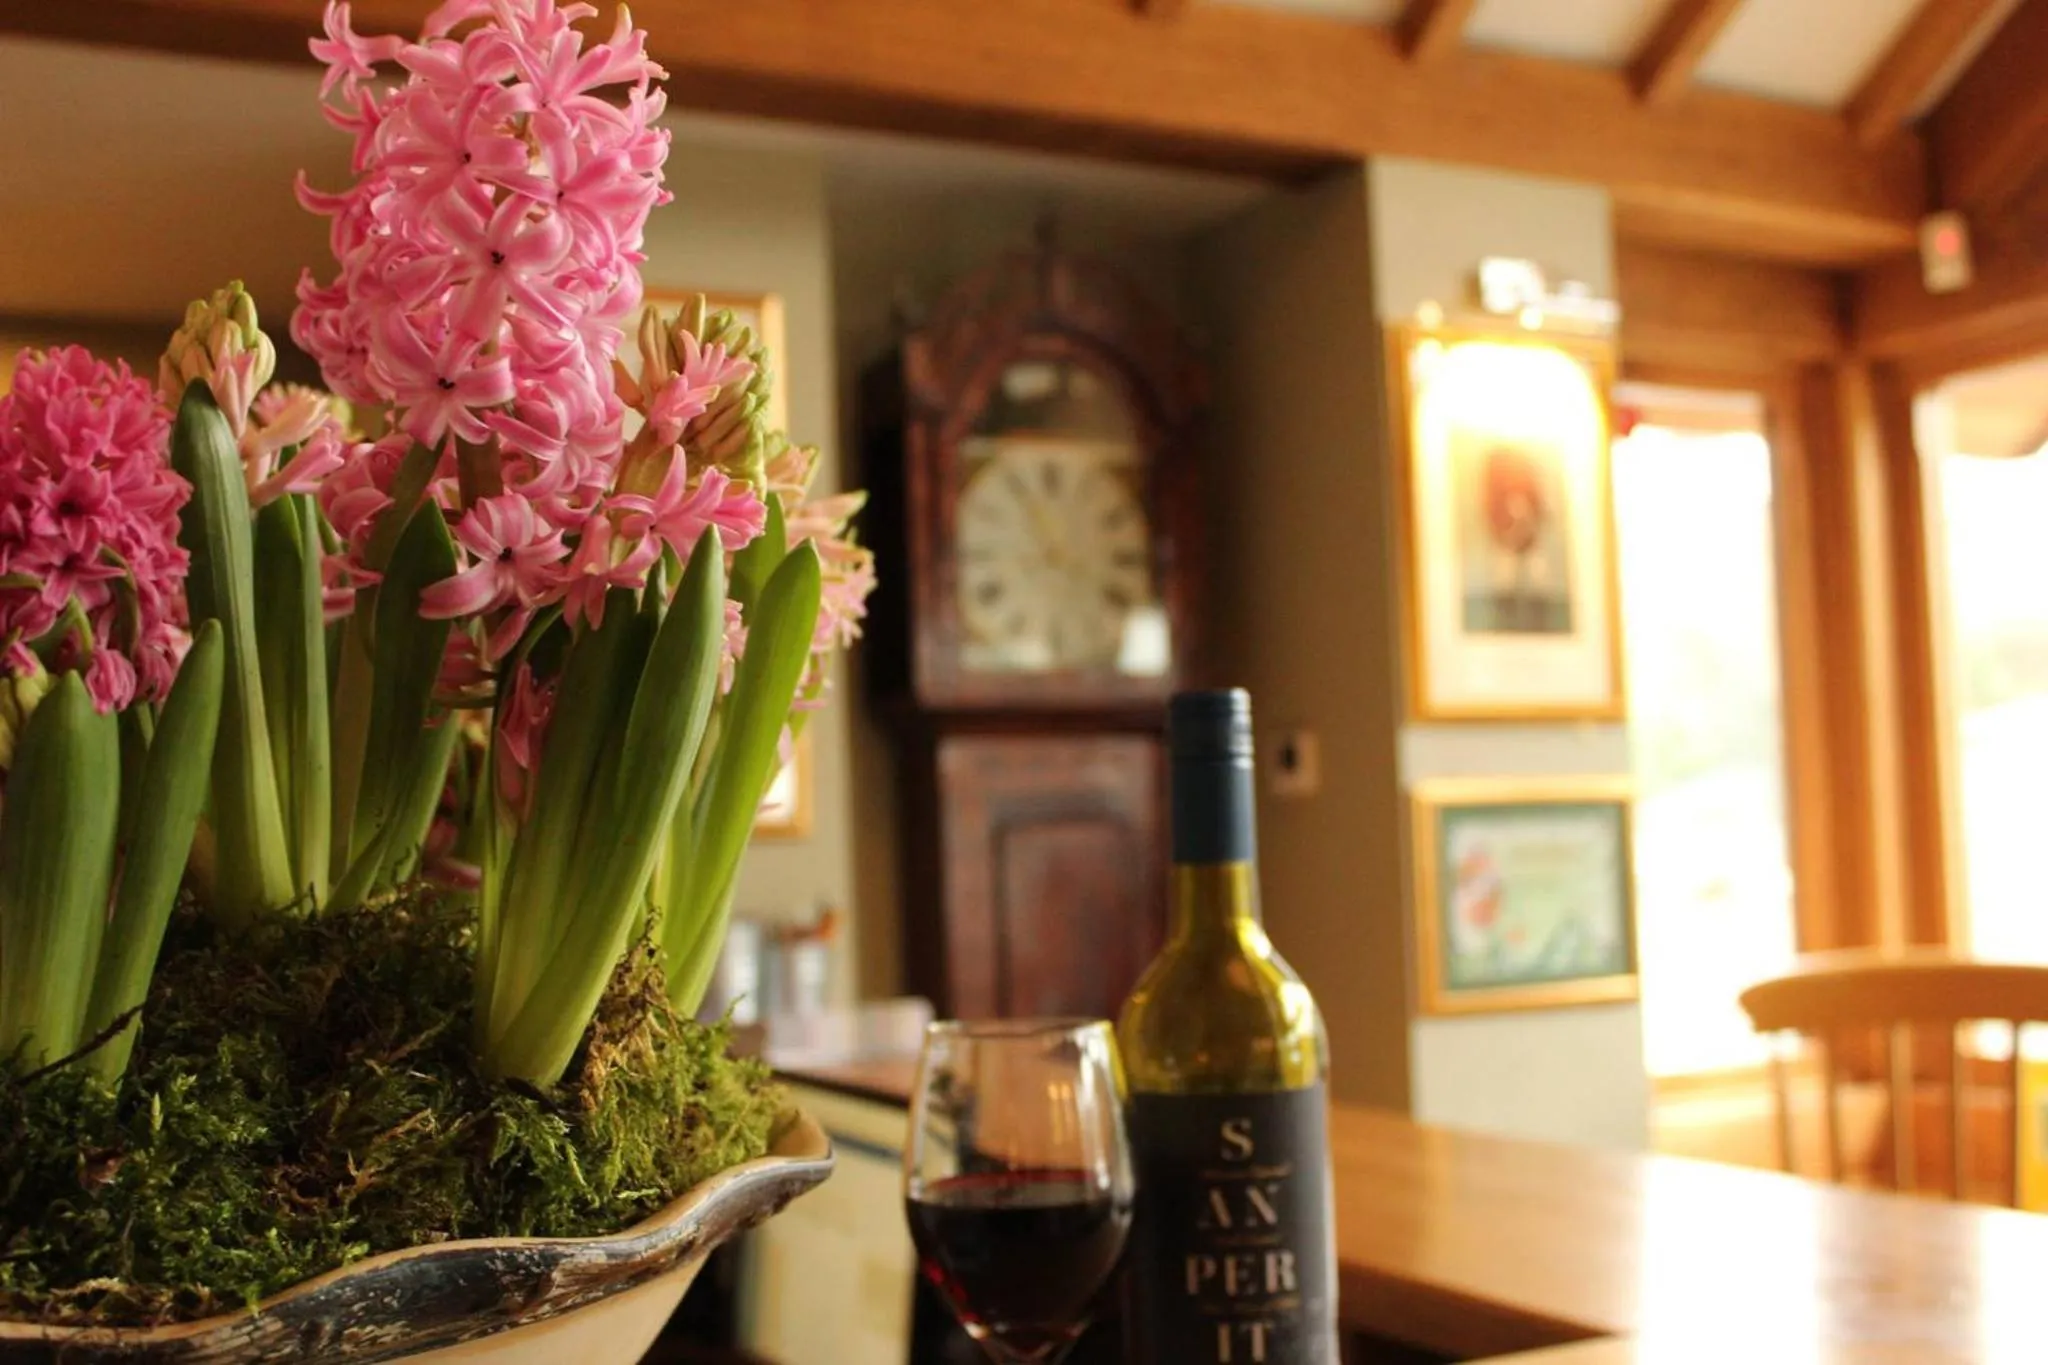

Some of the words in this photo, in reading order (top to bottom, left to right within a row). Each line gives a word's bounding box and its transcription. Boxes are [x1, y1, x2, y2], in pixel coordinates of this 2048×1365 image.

[1220, 1117, 1254, 1161] S
[1197, 1183, 1281, 1229] AN
[1185, 1250, 1297, 1296] PER
[1217, 1317, 1276, 1364] IT
